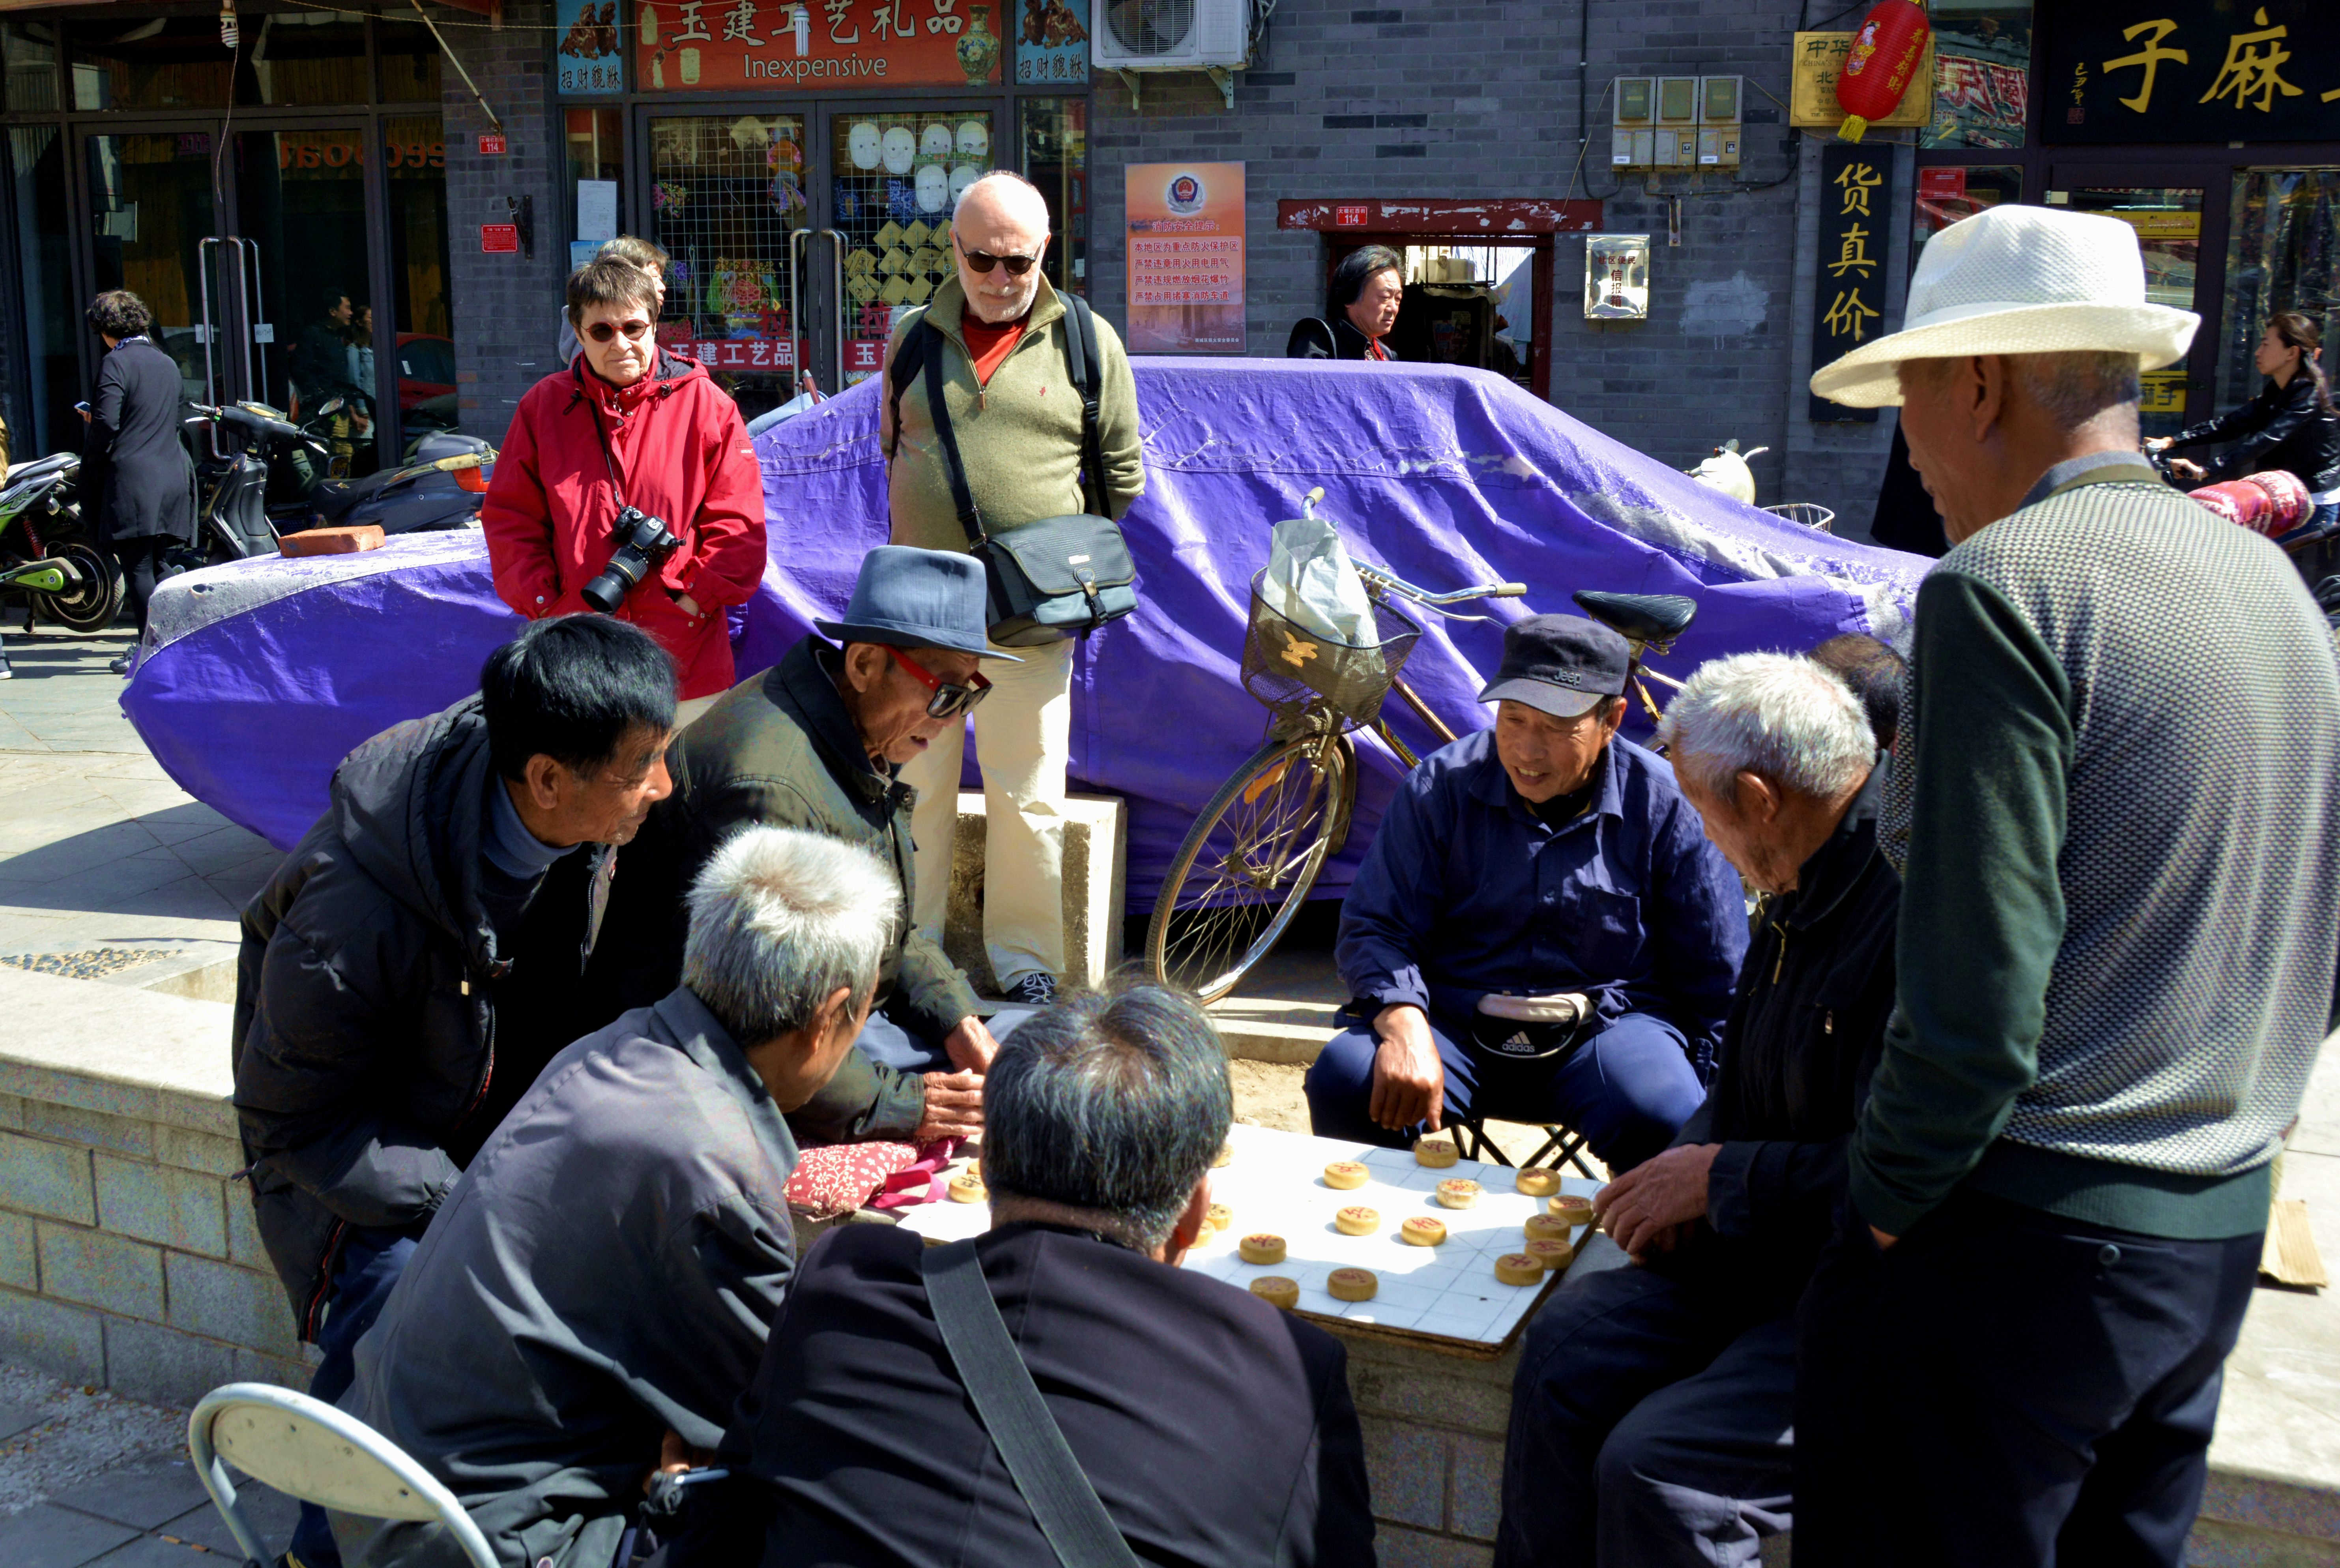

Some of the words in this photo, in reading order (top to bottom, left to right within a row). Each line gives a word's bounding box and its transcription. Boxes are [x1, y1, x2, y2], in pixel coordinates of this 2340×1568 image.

[1807, 39, 1850, 58] 中华
[744, 53, 887, 84] Inexpensive
[486, 143, 499, 152] 114
[1345, 214, 1359, 224] 114
[1134, 241, 1238, 252] 本地区为重点防火保护区
[1822, 163, 1882, 342] 货真价
[1134, 258, 1229, 269] 严禁违章用火用电用气
[1598, 256, 1636, 264] 社区便民
[1134, 274, 1229, 285] 严禁违规燃放烟花爆竹
[1611, 269, 1623, 307] 信报箱
[1134, 291, 1229, 301] 严禁占用堵塞消防车道
[758, 303, 789, 337] 拉
[859, 301, 892, 336] 拉
[855, 342, 887, 365] 玉
[1554, 668, 1582, 686] Jeep
[1502, 1043, 1535, 1053] adidas
